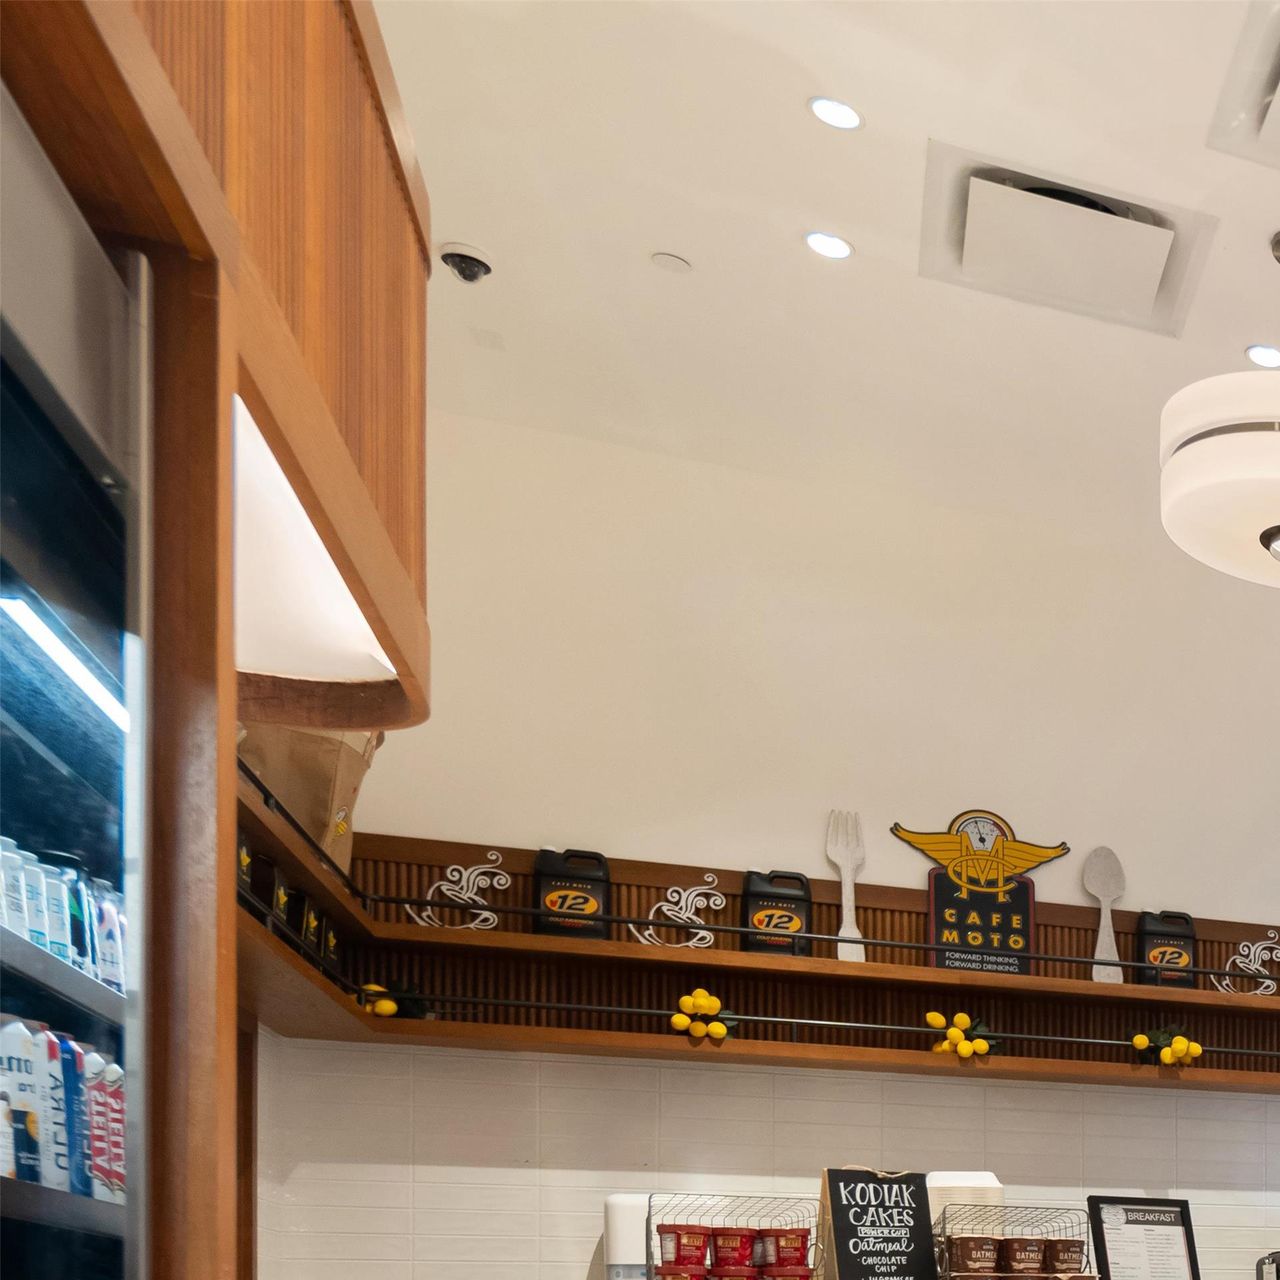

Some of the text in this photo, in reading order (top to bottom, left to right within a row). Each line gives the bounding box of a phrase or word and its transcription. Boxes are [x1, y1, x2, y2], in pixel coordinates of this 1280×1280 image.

[944, 908, 1023, 929] CAFE
[942, 930, 1025, 949] MOTO
[945, 951, 983, 962] FORWARD
[945, 960, 983, 970] FORWARD
[839, 1182, 917, 1207] KODIAK
[849, 1207, 915, 1227] CAKES
[1127, 1211, 1176, 1222] BREAKFAST
[849, 1238, 914, 1254] Oatmeal
[862, 1256, 907, 1264] CHOCOLATE
[972, 1250, 998, 1259] OATMEA
[1016, 1251, 1042, 1260] OATMEA
[1059, 1252, 1082, 1260] OATMEA
[875, 1264, 897, 1272] CHIP
